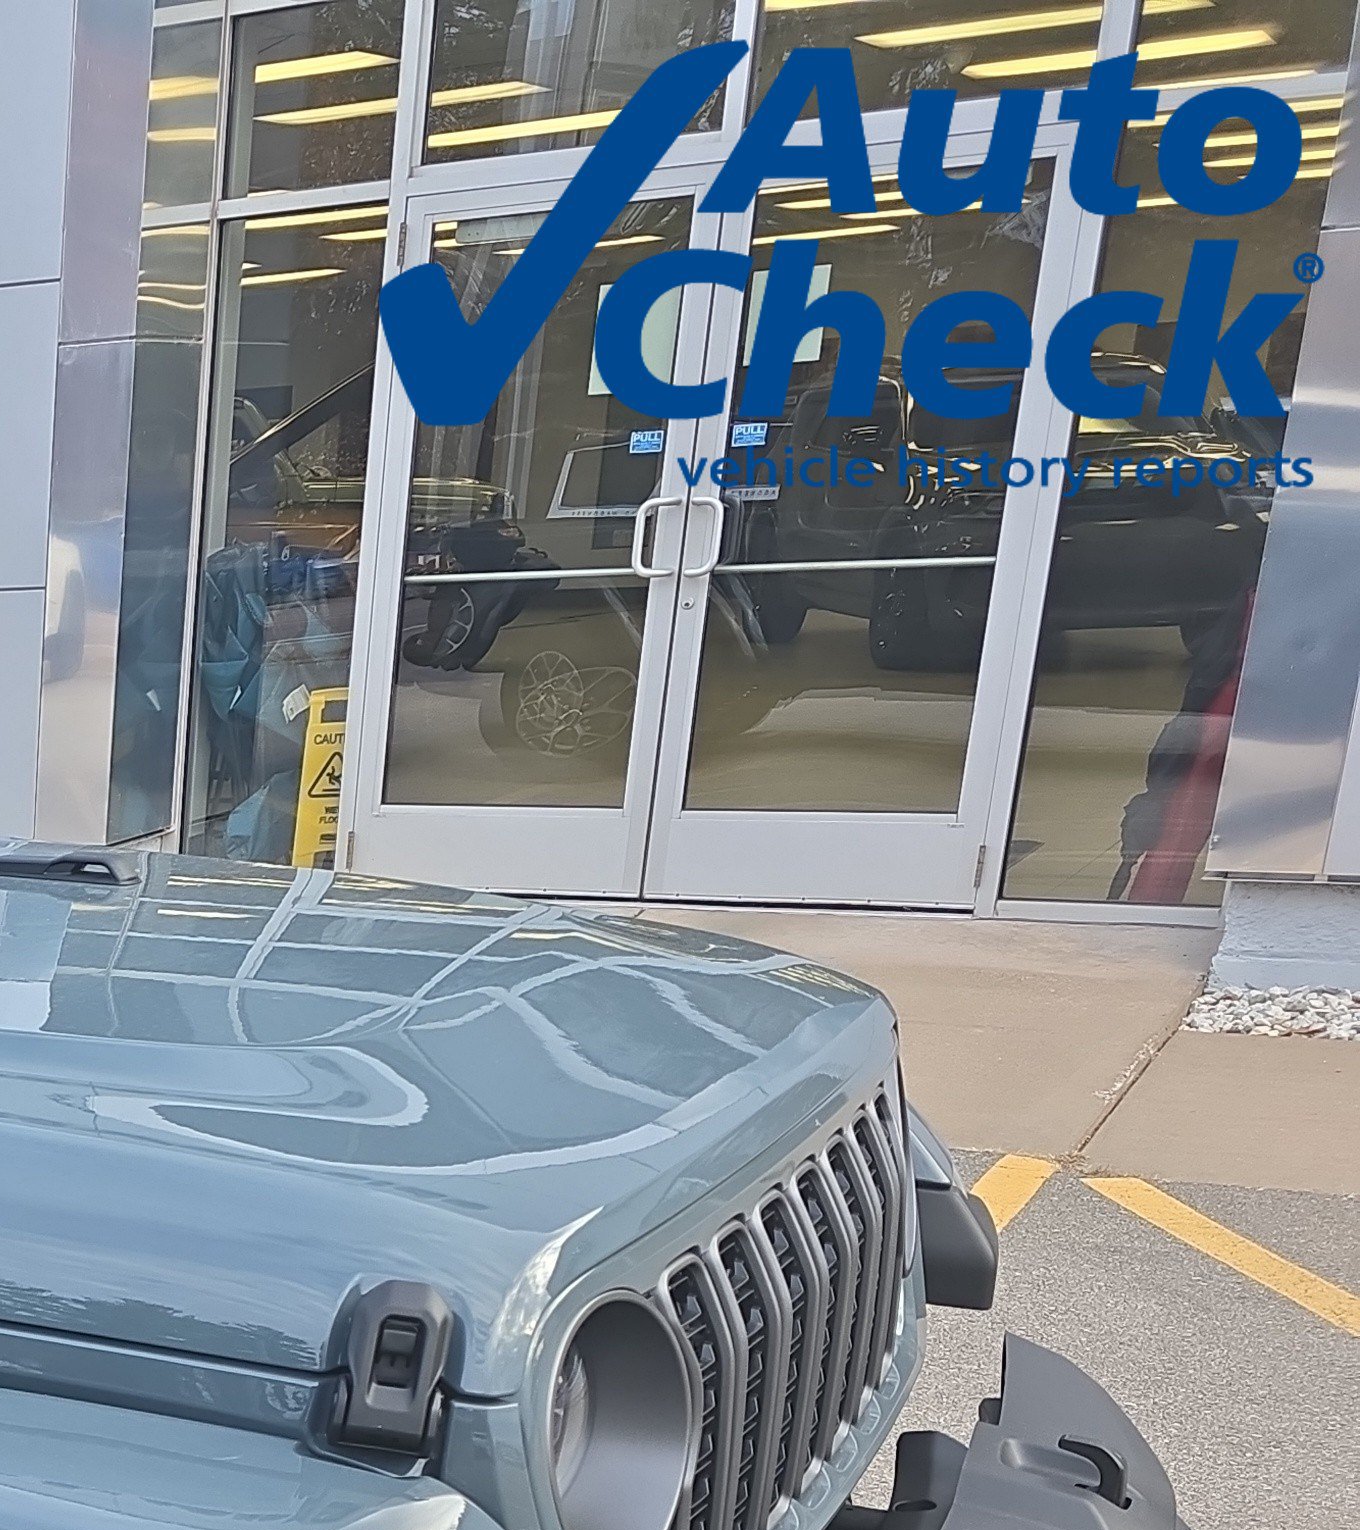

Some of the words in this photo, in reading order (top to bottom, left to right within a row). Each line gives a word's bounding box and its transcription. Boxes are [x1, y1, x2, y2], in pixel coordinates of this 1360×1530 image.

[735, 424, 765, 435] PULL
[634, 432, 661, 442] PULL
[314, 733, 347, 745] CAUT
[324, 806, 339, 815] WE
